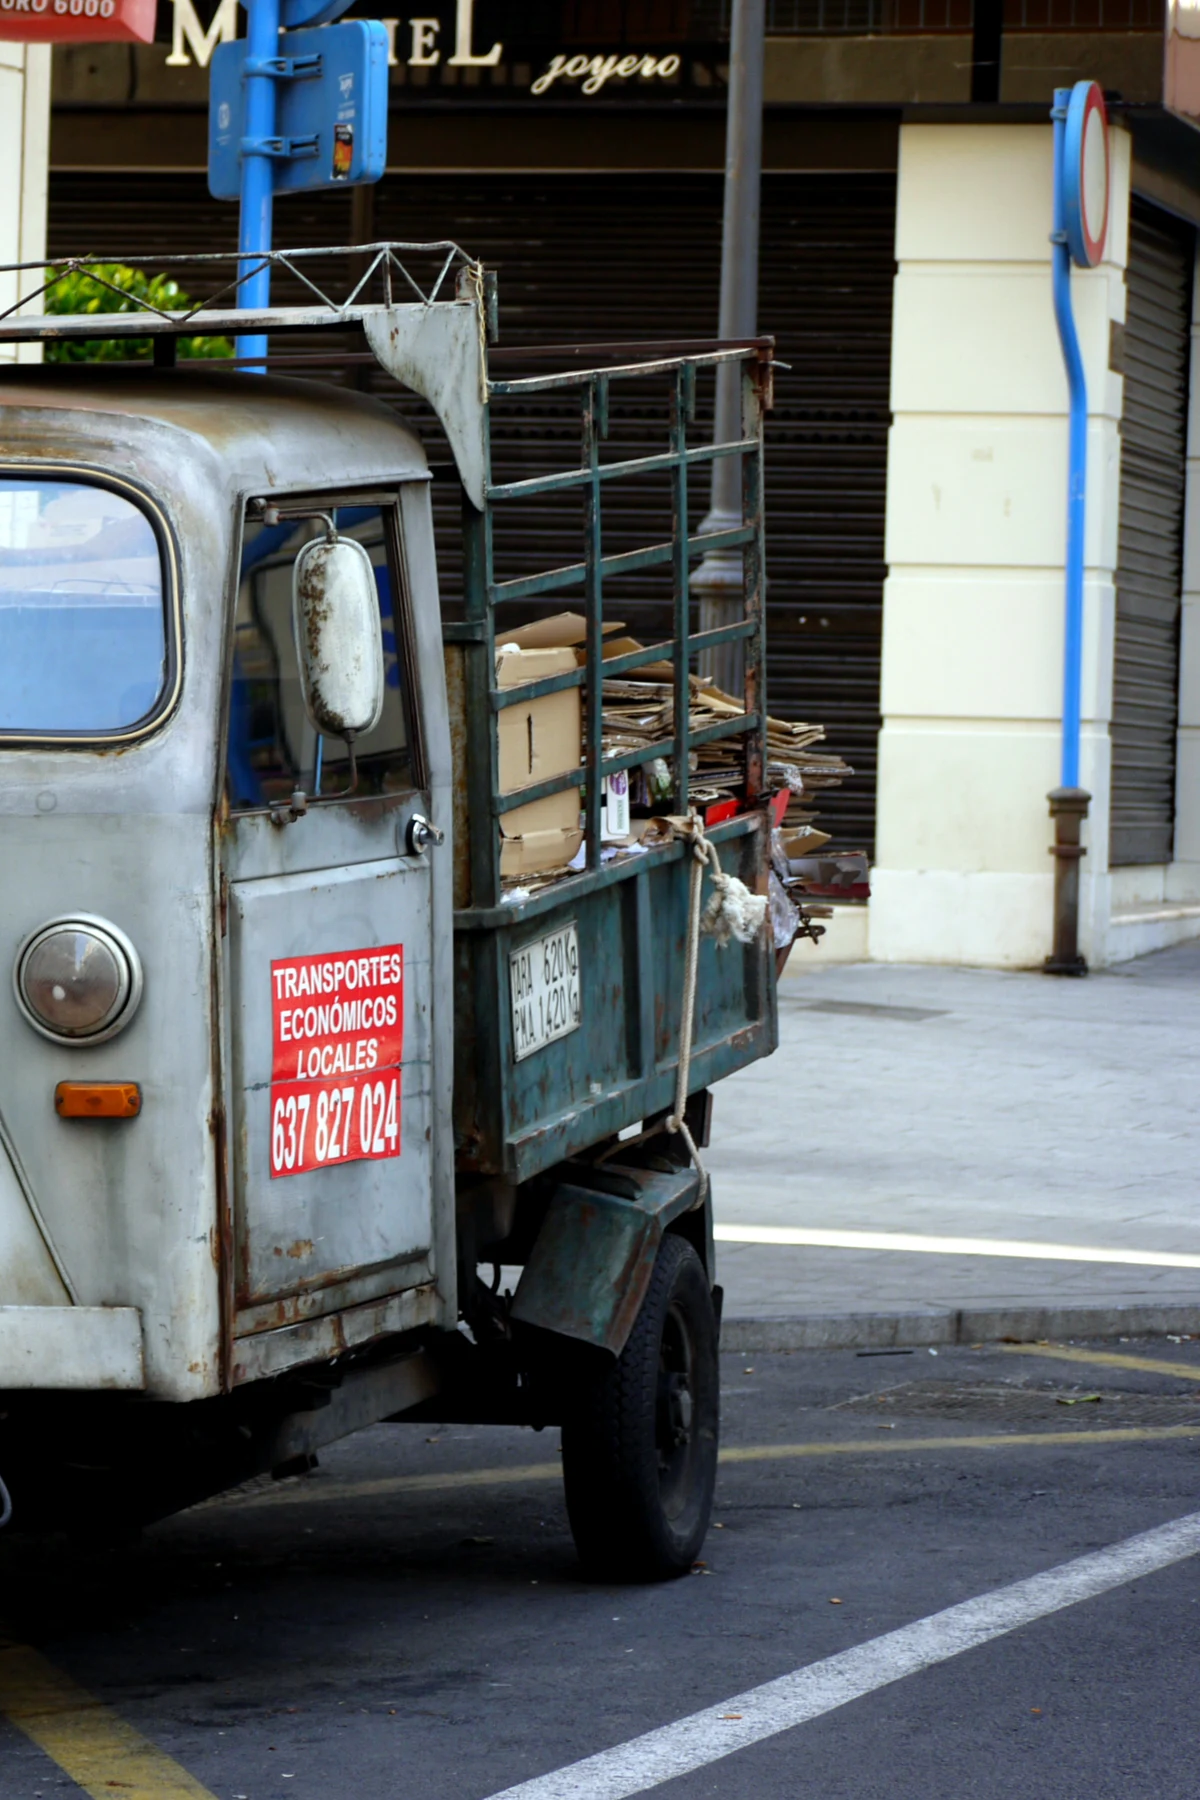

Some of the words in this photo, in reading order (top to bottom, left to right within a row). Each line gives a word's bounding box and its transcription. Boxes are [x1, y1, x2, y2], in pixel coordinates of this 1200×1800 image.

[53, 0, 115, 18] 6000
[530, 54, 681, 95] joyero
[273, 953, 402, 1000] TRANSPORTES
[280, 995, 397, 1042] ECONÓMICOS
[296, 1037, 378, 1080] LOCALES
[272, 1093, 311, 1171] 637
[315, 1086, 355, 1162] 827
[359, 1078, 398, 1154] 024
